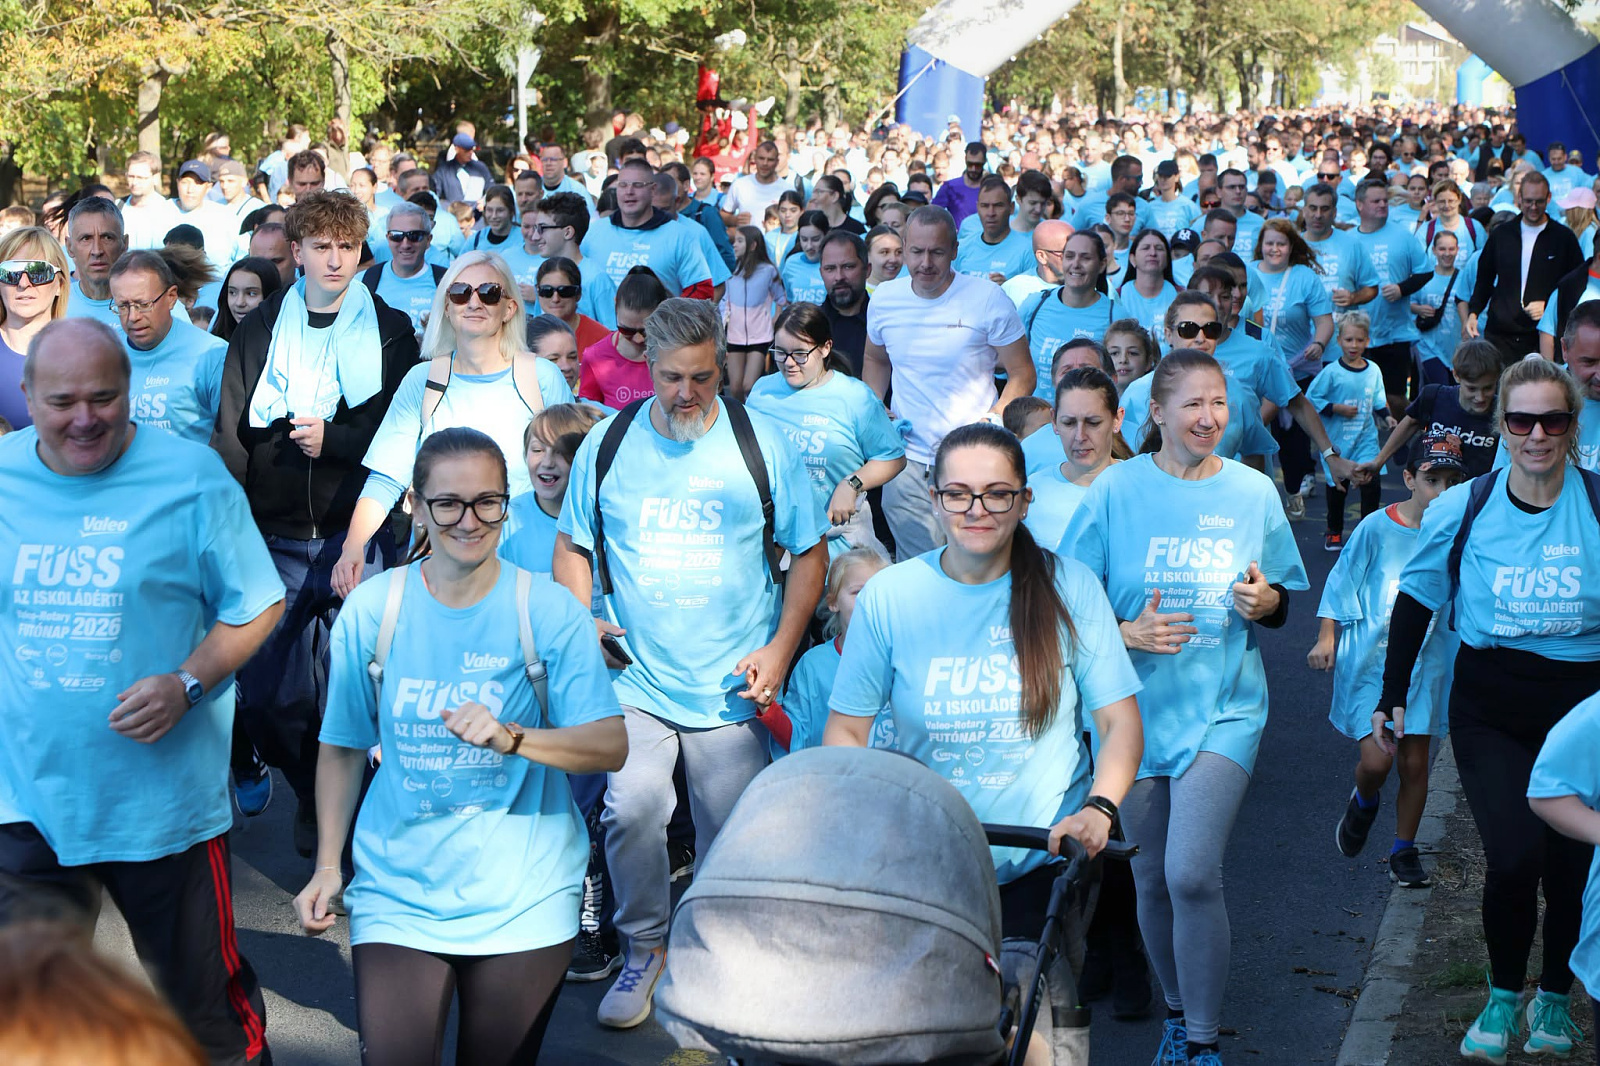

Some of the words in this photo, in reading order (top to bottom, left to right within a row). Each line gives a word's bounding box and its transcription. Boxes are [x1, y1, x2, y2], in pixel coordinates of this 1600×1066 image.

[1431, 422, 1495, 448] adidas
[688, 475, 724, 489] Valeo
[83, 516, 128, 533] Valeo
[1198, 513, 1234, 528] Valeo
[1542, 543, 1580, 556] Valeo
[1144, 572, 1160, 583] AZ
[1163, 570, 1238, 583] ISKOLÁDÉRT
[14, 591, 31, 604] AZ
[33, 588, 124, 607] ISKOLÁDÉRT!
[1507, 599, 1583, 614] ISKOLÁDÉRT!
[18, 622, 70, 639] FUTÓNAP
[70, 616, 121, 637] 2026
[462, 651, 510, 669] Valeo
[924, 701, 942, 716] AZ
[393, 722, 409, 737] AZ
[925, 720, 987, 730] Valeo-Rotary
[929, 731, 987, 744] FUTÓNAP
[988, 721, 1031, 739] 202
[395, 742, 453, 755] Valeo-Rotary
[399, 755, 453, 771] FUTÓNAP
